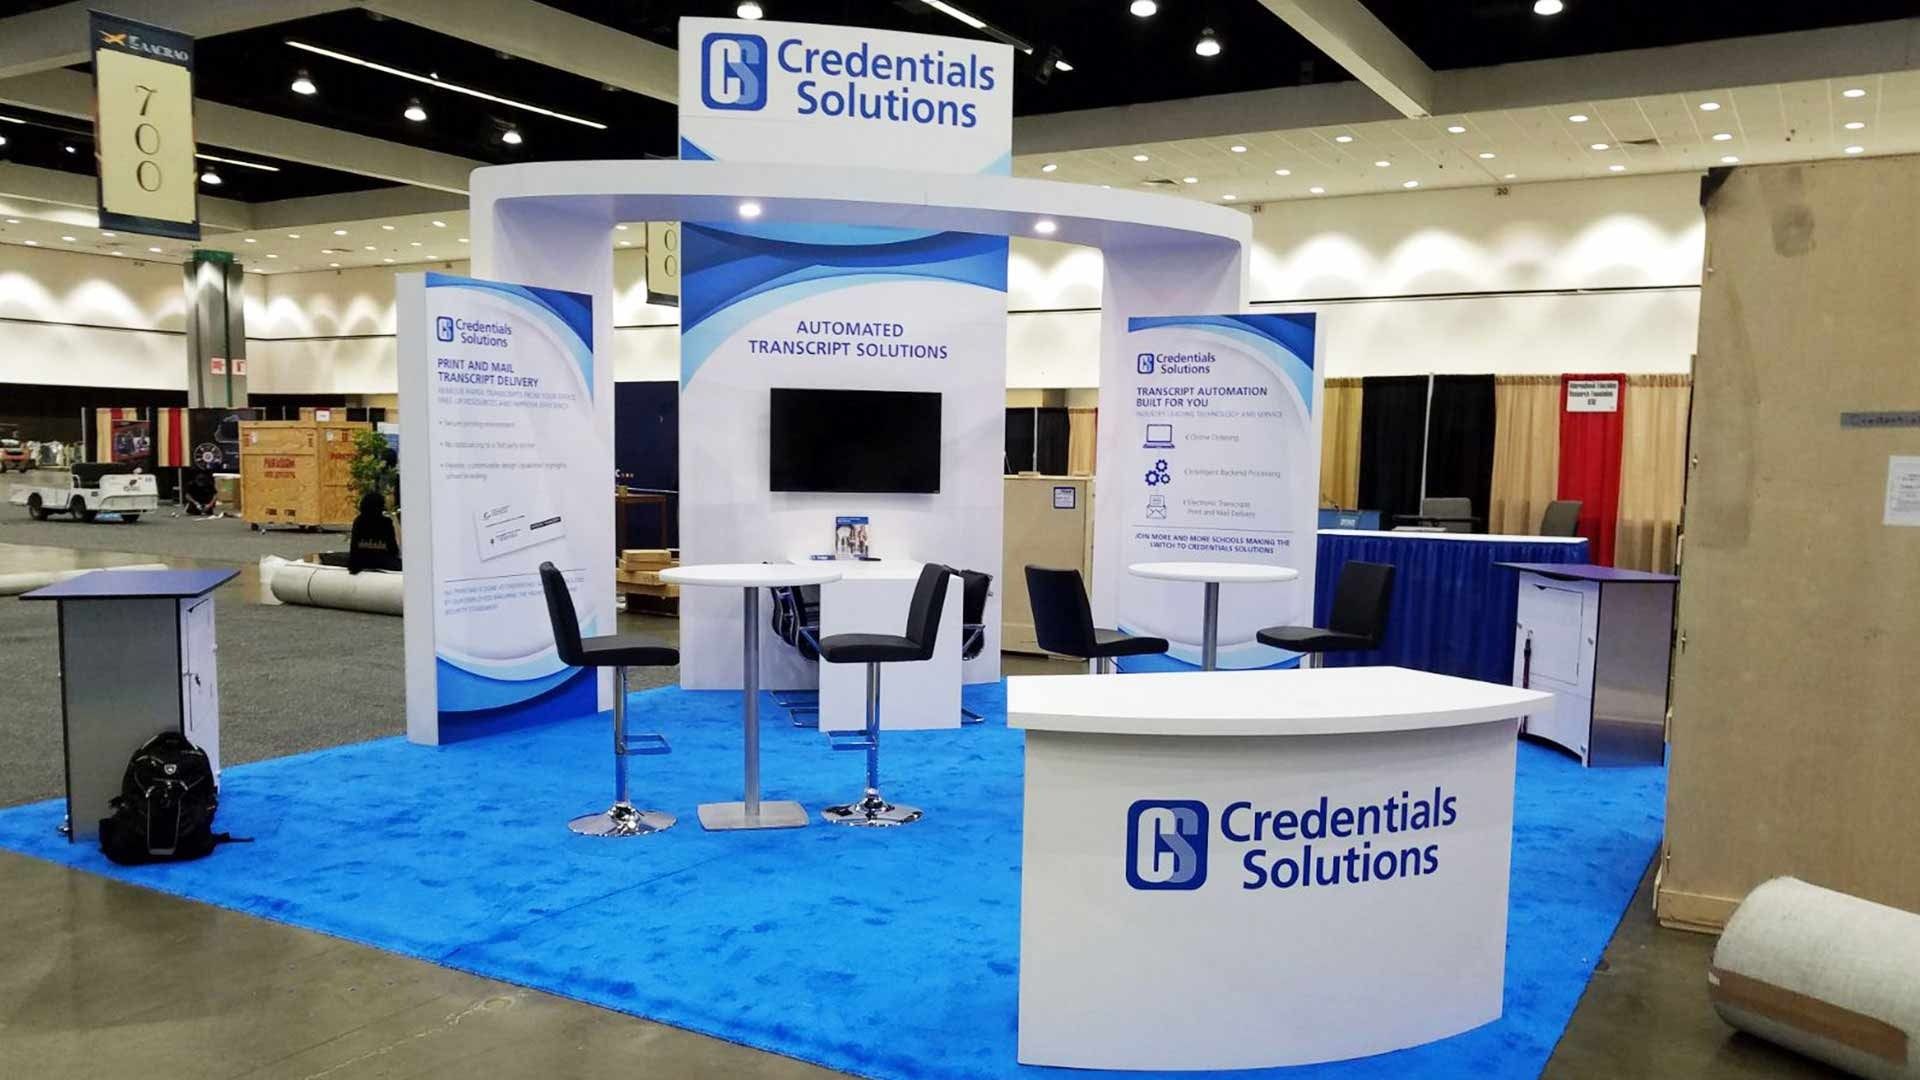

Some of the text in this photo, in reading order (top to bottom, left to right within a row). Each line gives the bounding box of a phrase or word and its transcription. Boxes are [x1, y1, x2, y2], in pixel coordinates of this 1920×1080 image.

[777, 38, 995, 91] Credentials
[797, 80, 977, 128] Solutions
[134, 85, 162, 192] 700
[456, 318, 513, 336] Credentials
[796, 320, 904, 337] AUTOMATED
[461, 332, 509, 348] Solutions
[748, 340, 948, 359] TRANSCRIPT SOLUTIONS
[1156, 352, 1216, 364] Credentials
[437, 358, 514, 373] PRINT AND MAIL
[1161, 363, 1210, 375] Solutions
[438, 371, 539, 388] TRANSCRIPT DELIVERY
[1136, 387, 1268, 397] TRANSCRIPT AUTOMATION
[1136, 398, 1209, 408] BUILT FOR YOU
[1187, 543, 1232, 552] CREDENTIALS
[1234, 545, 1274, 554] SOLUTIONS
[1190, 535, 1210, 543] MORE
[1212, 536, 1243, 544] SCHOOLS
[1246, 537, 1275, 545] MAKING
[1277, 538, 1290, 546] THE
[1220, 787, 1457, 842] Credentials
[1242, 842, 1440, 890] Solutions
